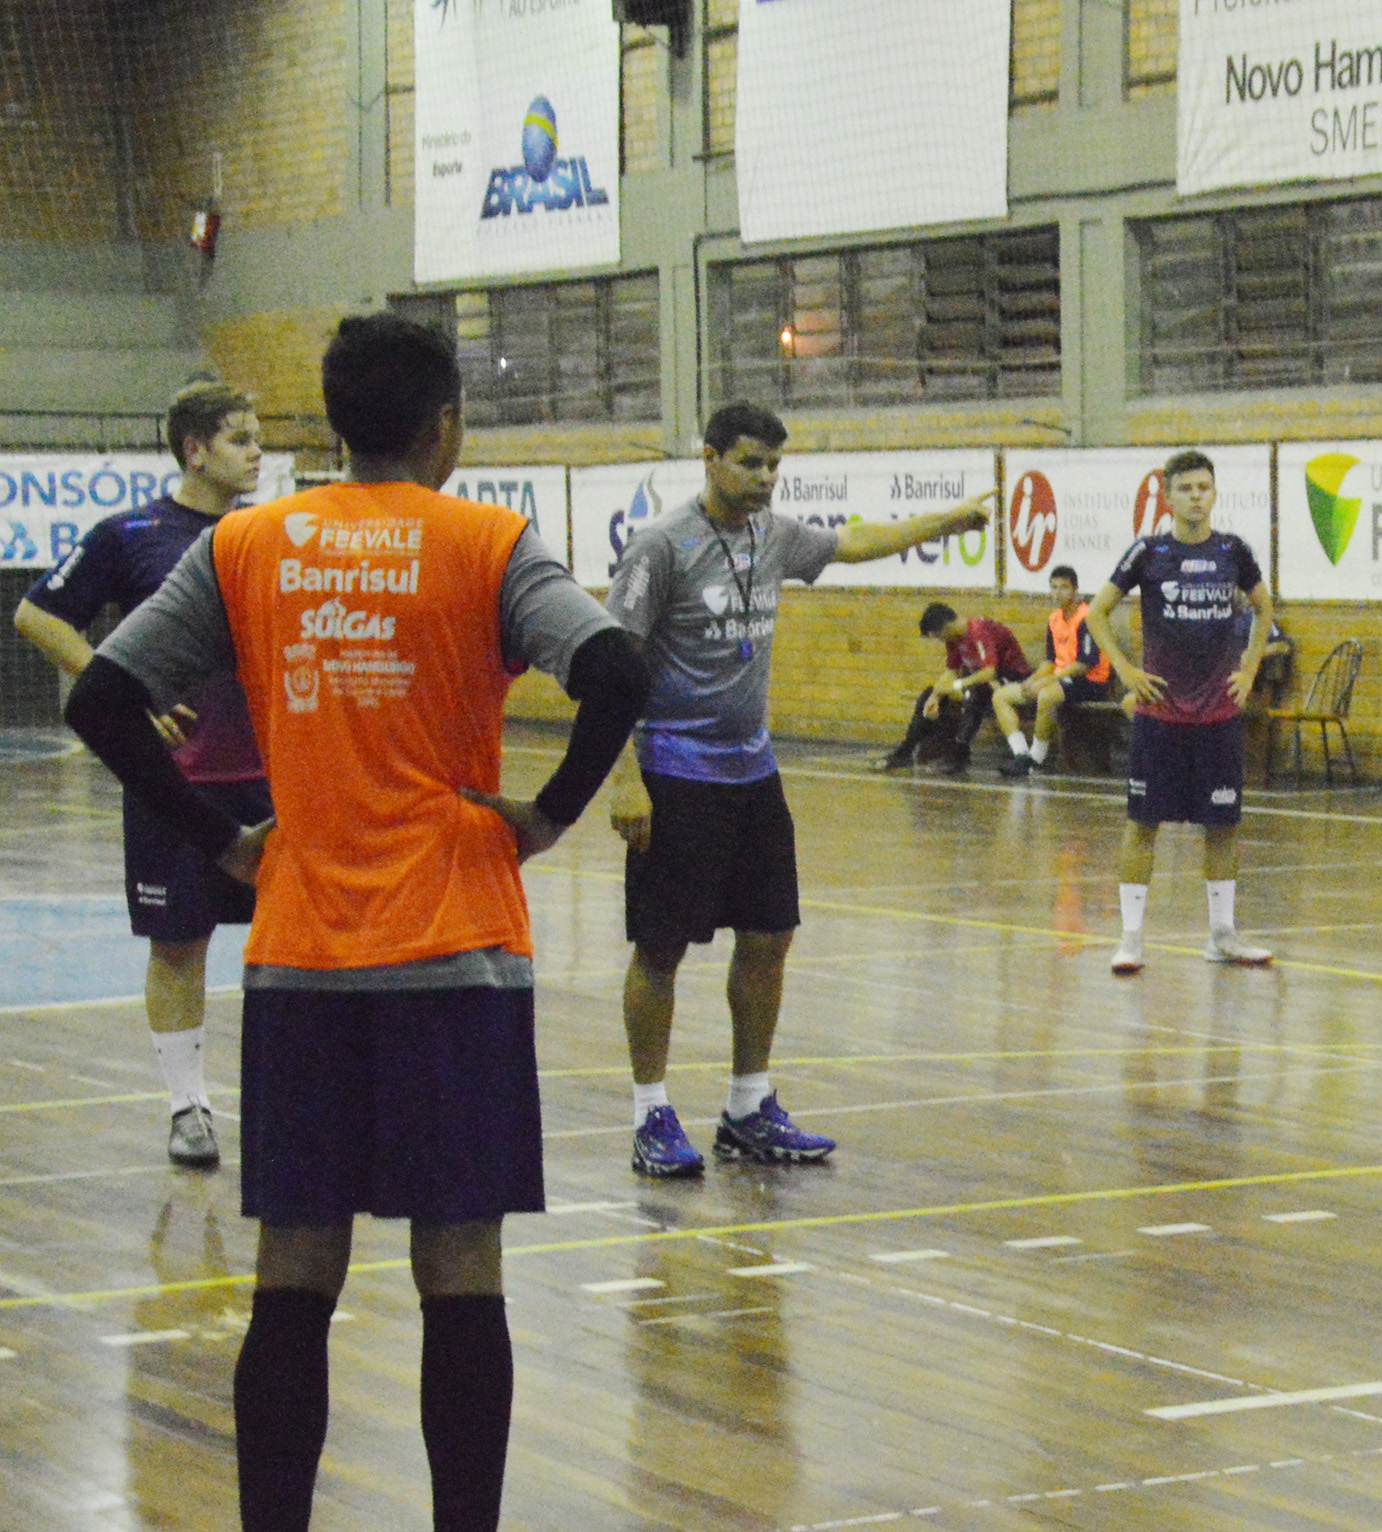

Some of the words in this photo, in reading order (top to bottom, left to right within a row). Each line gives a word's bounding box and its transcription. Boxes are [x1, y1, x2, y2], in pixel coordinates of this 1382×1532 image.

[1225, 53, 1303, 104] Novo
[480, 155, 610, 221] BRASIL
[793, 475, 848, 500] Banrisul
[904, 471, 965, 499] Banrisul
[1063, 492, 1130, 509] INSTITUTO
[1215, 491, 1268, 508] TITUTO
[319, 528, 423, 550] FEEVALE
[279, 558, 420, 595] Banrisul
